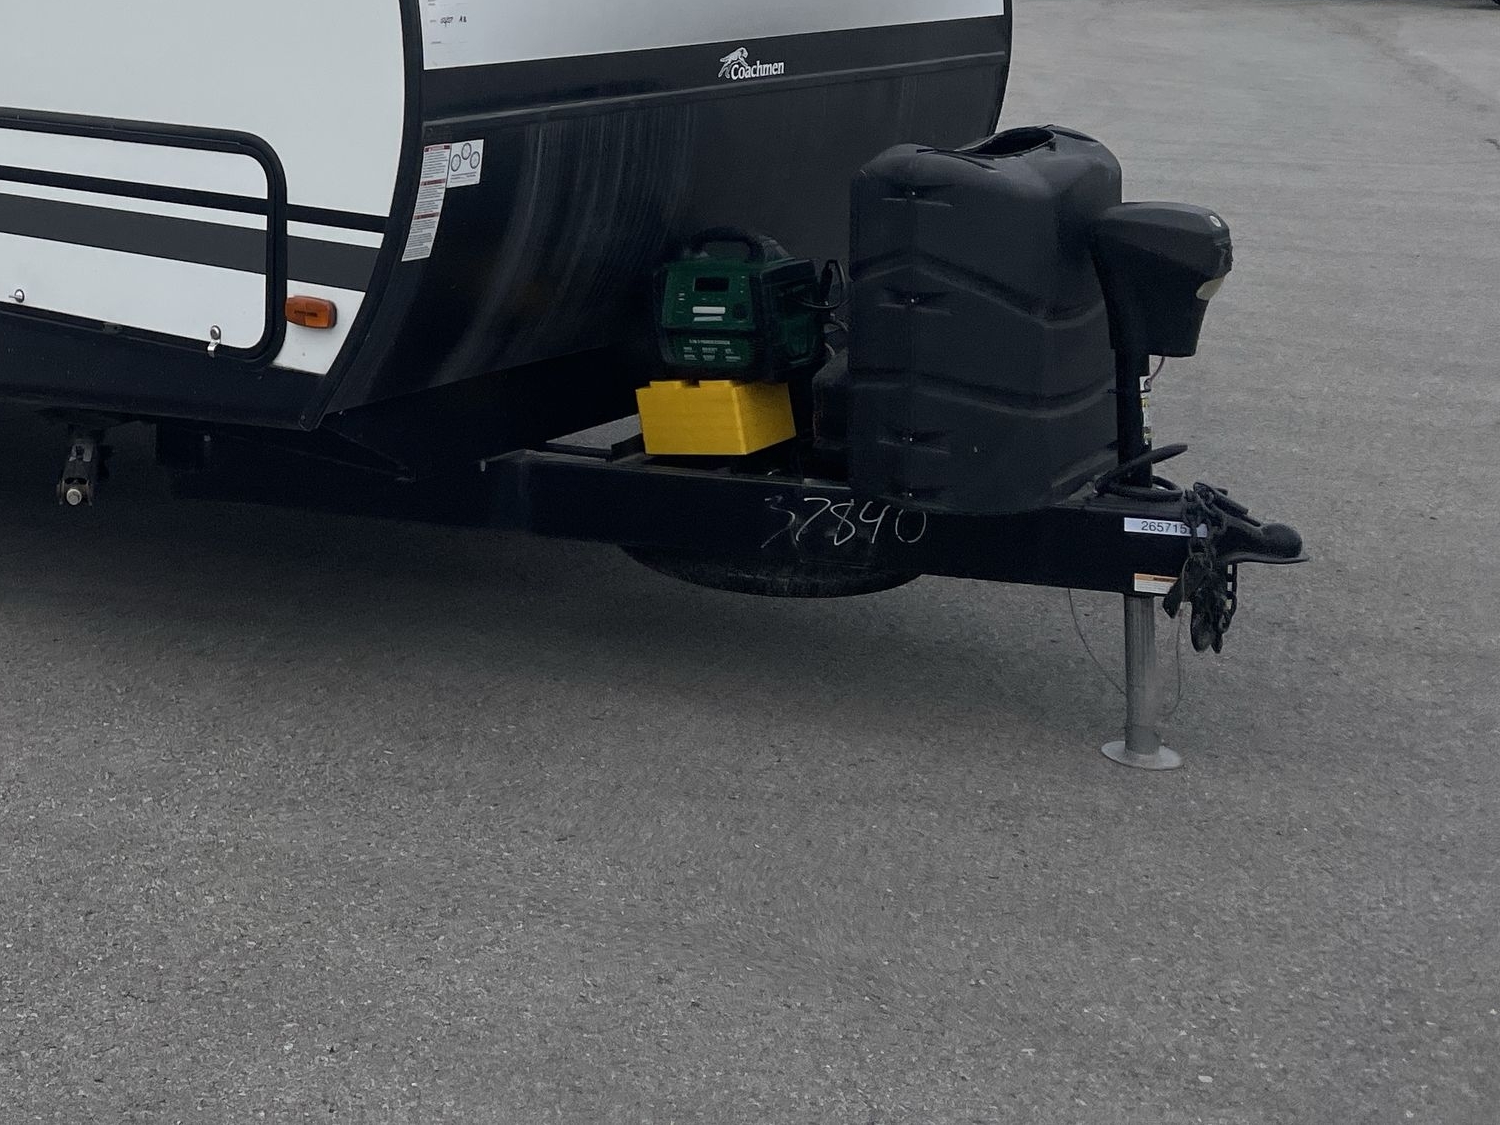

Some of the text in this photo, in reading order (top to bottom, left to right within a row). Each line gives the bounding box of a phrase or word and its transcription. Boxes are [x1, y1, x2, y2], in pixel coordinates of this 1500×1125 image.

[731, 60, 785, 80] Coachmen
[760, 495, 927, 550] 37840
[1141, 520, 1190, 535] 265715
